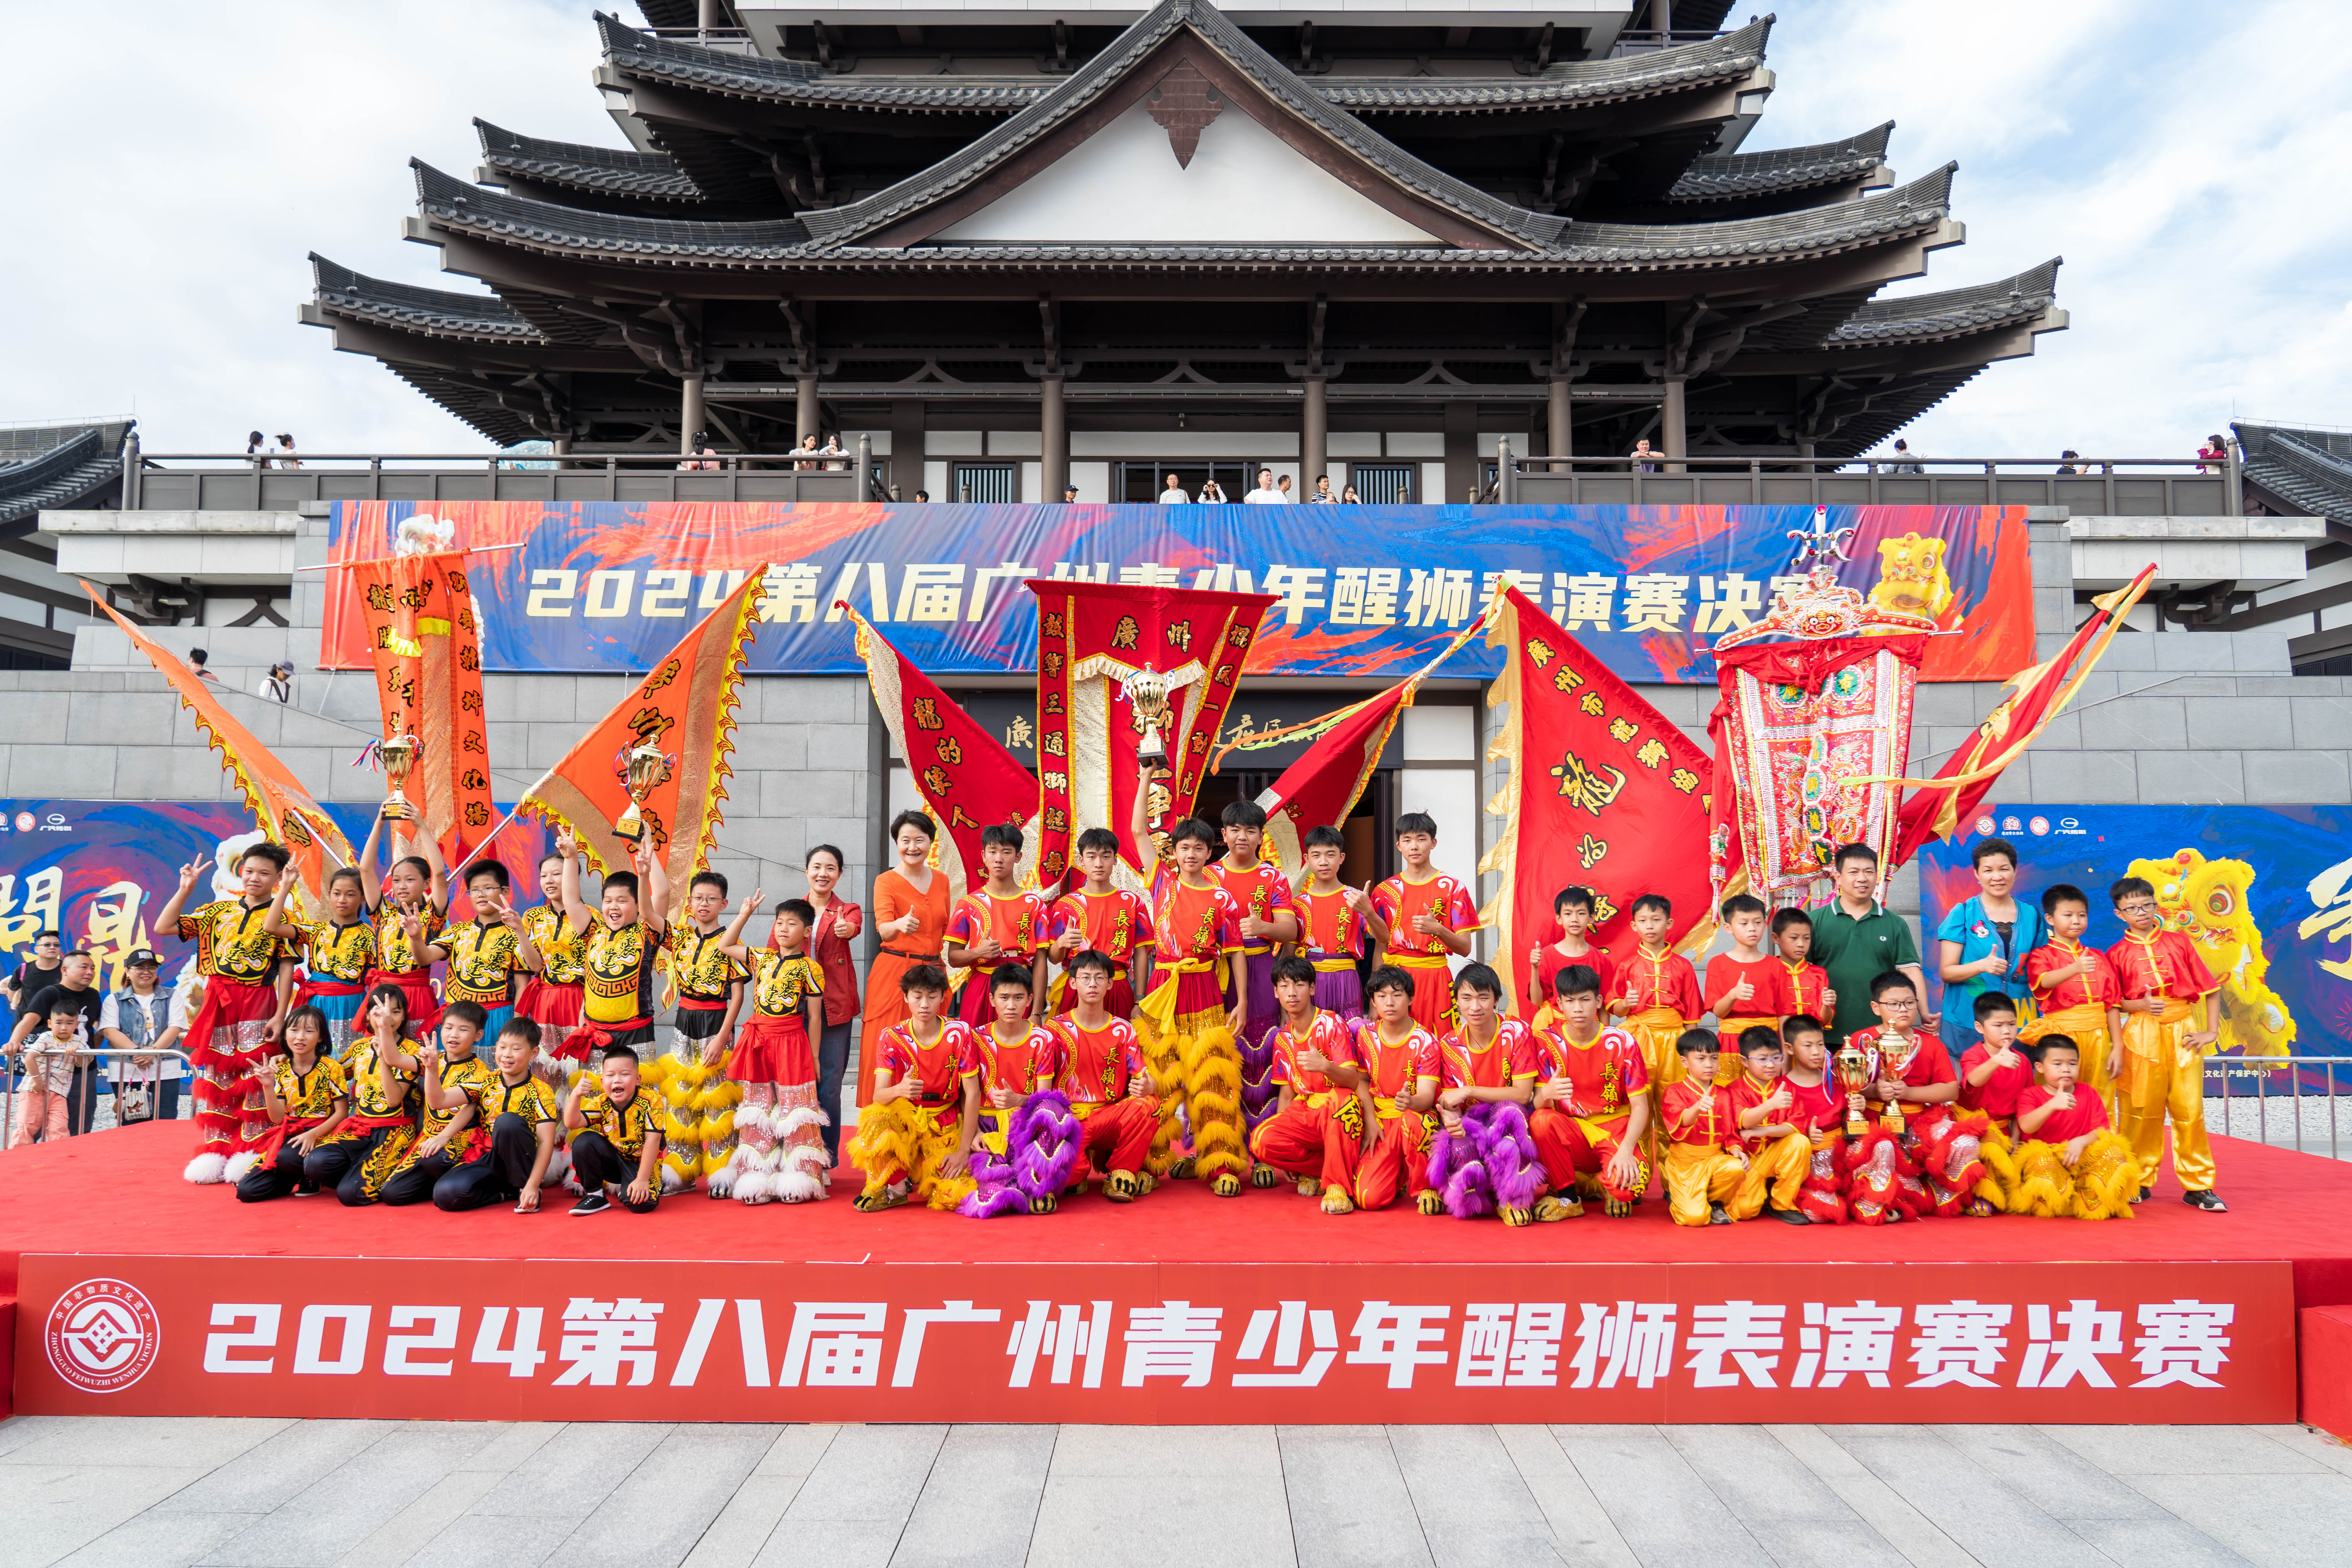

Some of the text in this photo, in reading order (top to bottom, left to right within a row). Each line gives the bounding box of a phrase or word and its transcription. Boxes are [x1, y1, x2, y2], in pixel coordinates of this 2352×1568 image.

[1111, 615, 1192, 653] 廣州
[1176, 622, 1252, 824] 棍風一動虎
[912, 697, 980, 829] 龍的傳人
[1427, 898, 1448, 953] 長街
[55, 1283, 152, 1321] 中国非物质文化遗产
[51, 1331, 153, 1386] ZHONGGUO FEIWUZHI WENHUA YICHAN
[203, 1297, 2236, 1389] 2024第八届广州青少年醒狮表演赛决赛
